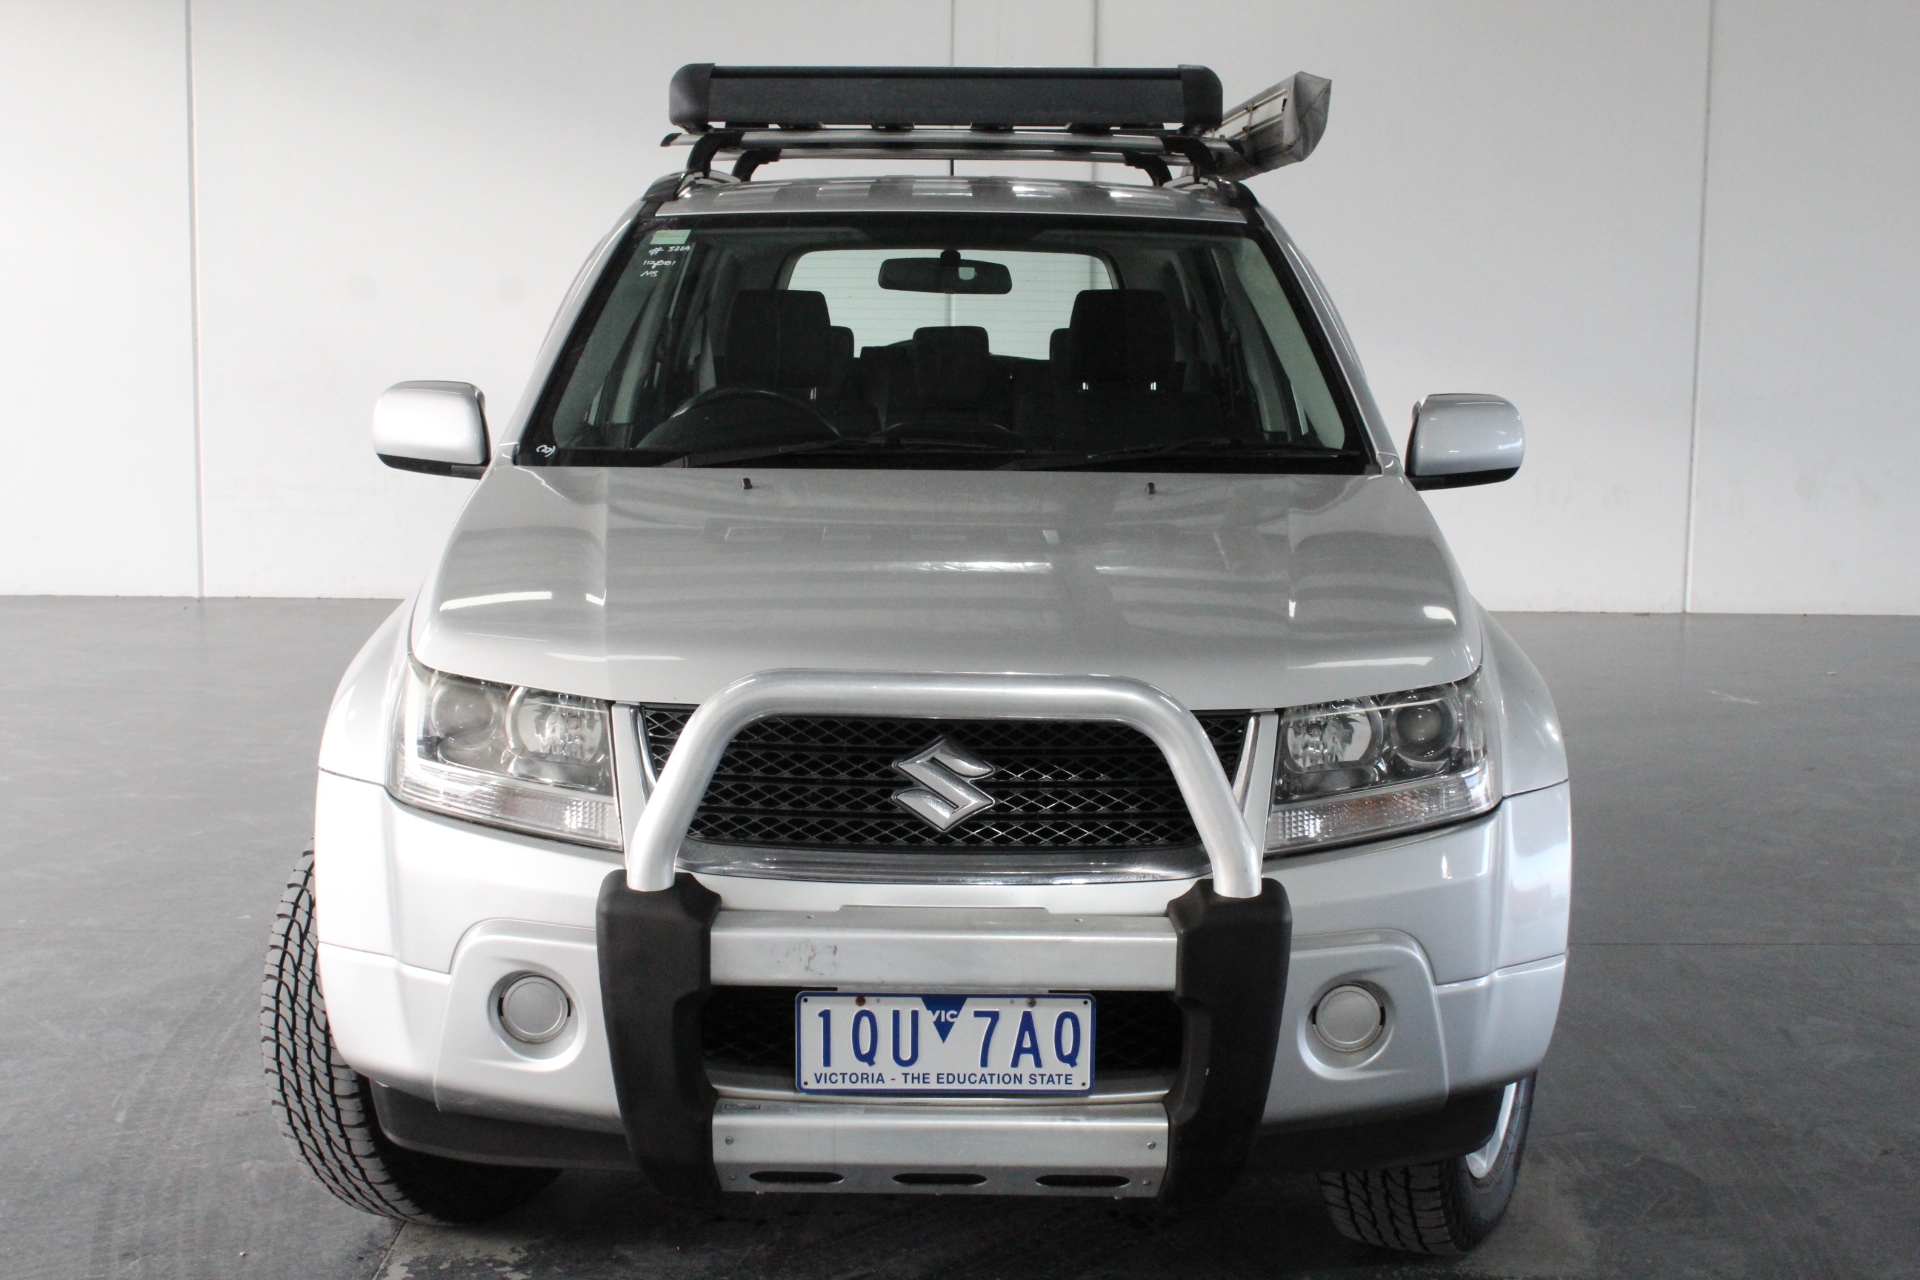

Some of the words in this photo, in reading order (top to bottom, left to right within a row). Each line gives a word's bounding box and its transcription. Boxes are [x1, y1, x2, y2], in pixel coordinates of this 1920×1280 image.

[928, 1010, 958, 1023] VIC
[818, 1009, 919, 1068] 1QU
[973, 1010, 1081, 1069] 7AQ
[814, 1073, 885, 1084] VICTORIA
[902, 1073, 931, 1084] THE
[936, 1073, 1023, 1085] EDUCATION
[1029, 1073, 1073, 1085] STATE
